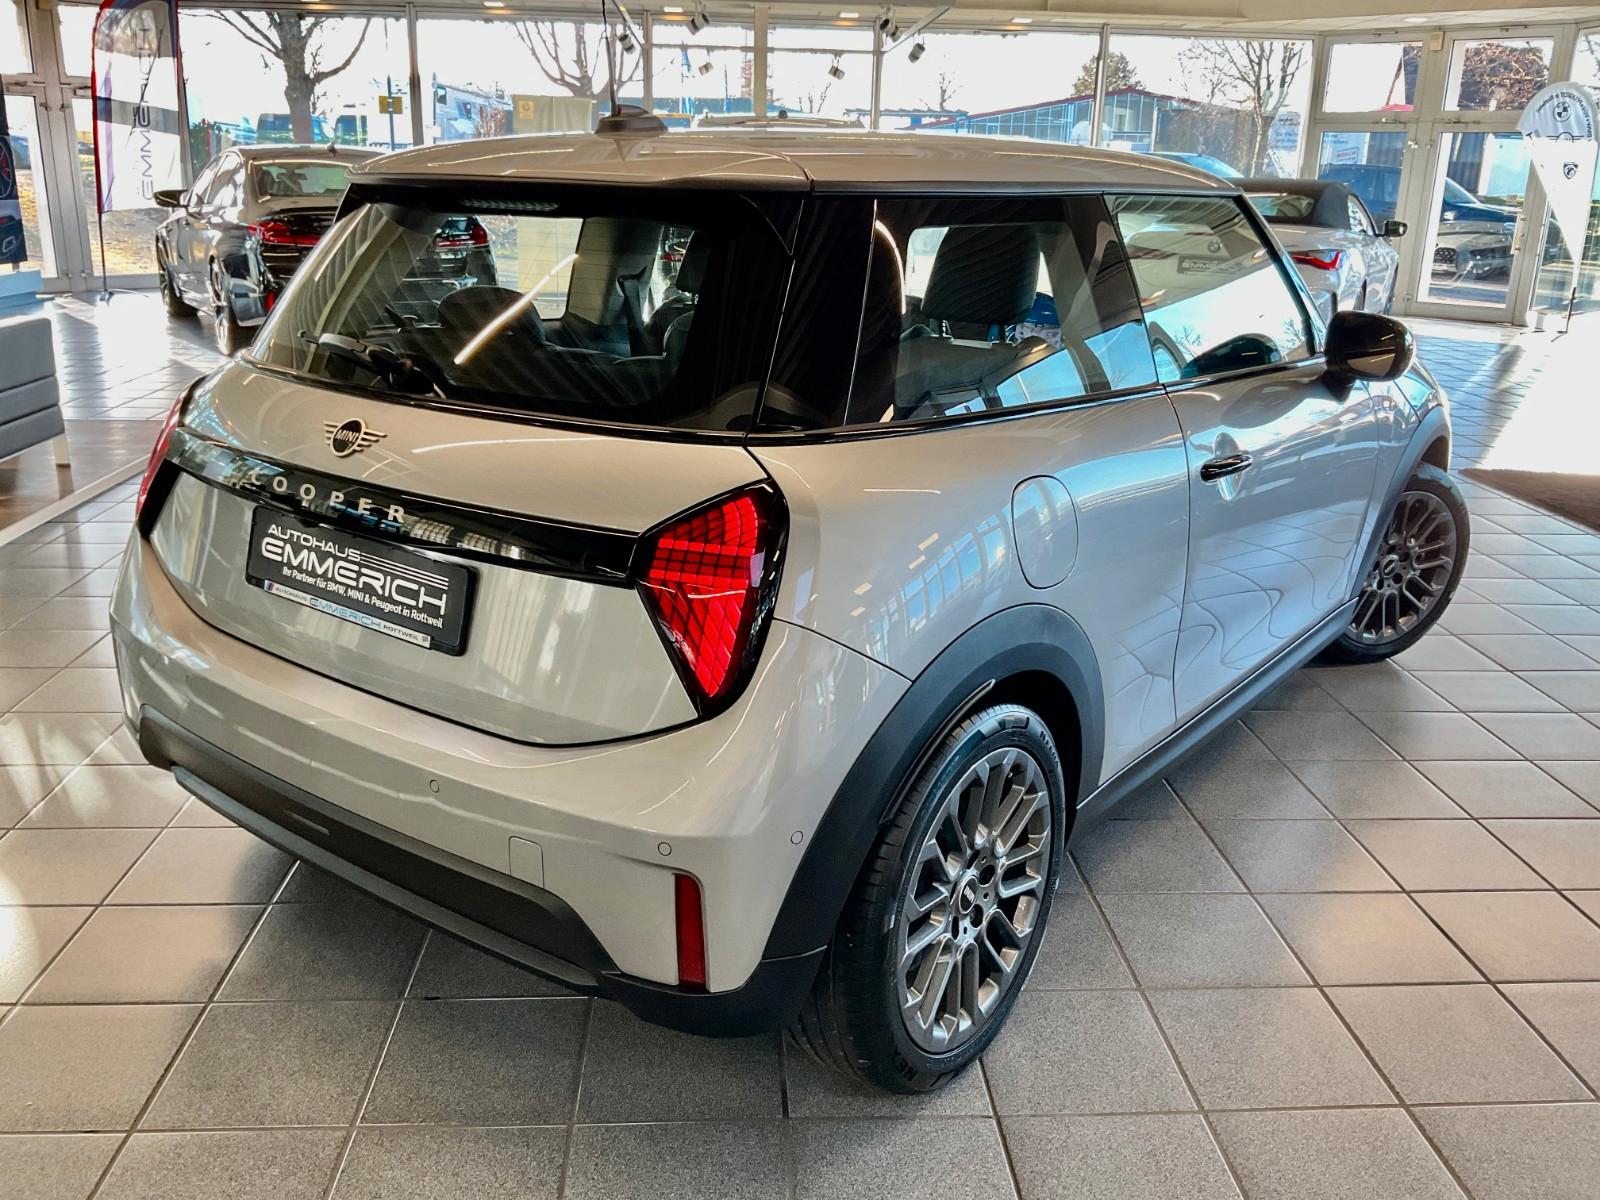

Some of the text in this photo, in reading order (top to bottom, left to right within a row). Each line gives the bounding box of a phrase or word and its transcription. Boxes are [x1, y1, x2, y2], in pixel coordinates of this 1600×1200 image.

[335, 429, 360, 443] MINI
[250, 466, 405, 524] COOPER
[267, 523, 361, 563] AUTOHAUS
[261, 536, 447, 616] EMMERICH
[282, 566, 443, 629] Ihr Partner für BMW, MINI & Peugeot in Rottweil
[309, 596, 381, 629] EMMERICH
